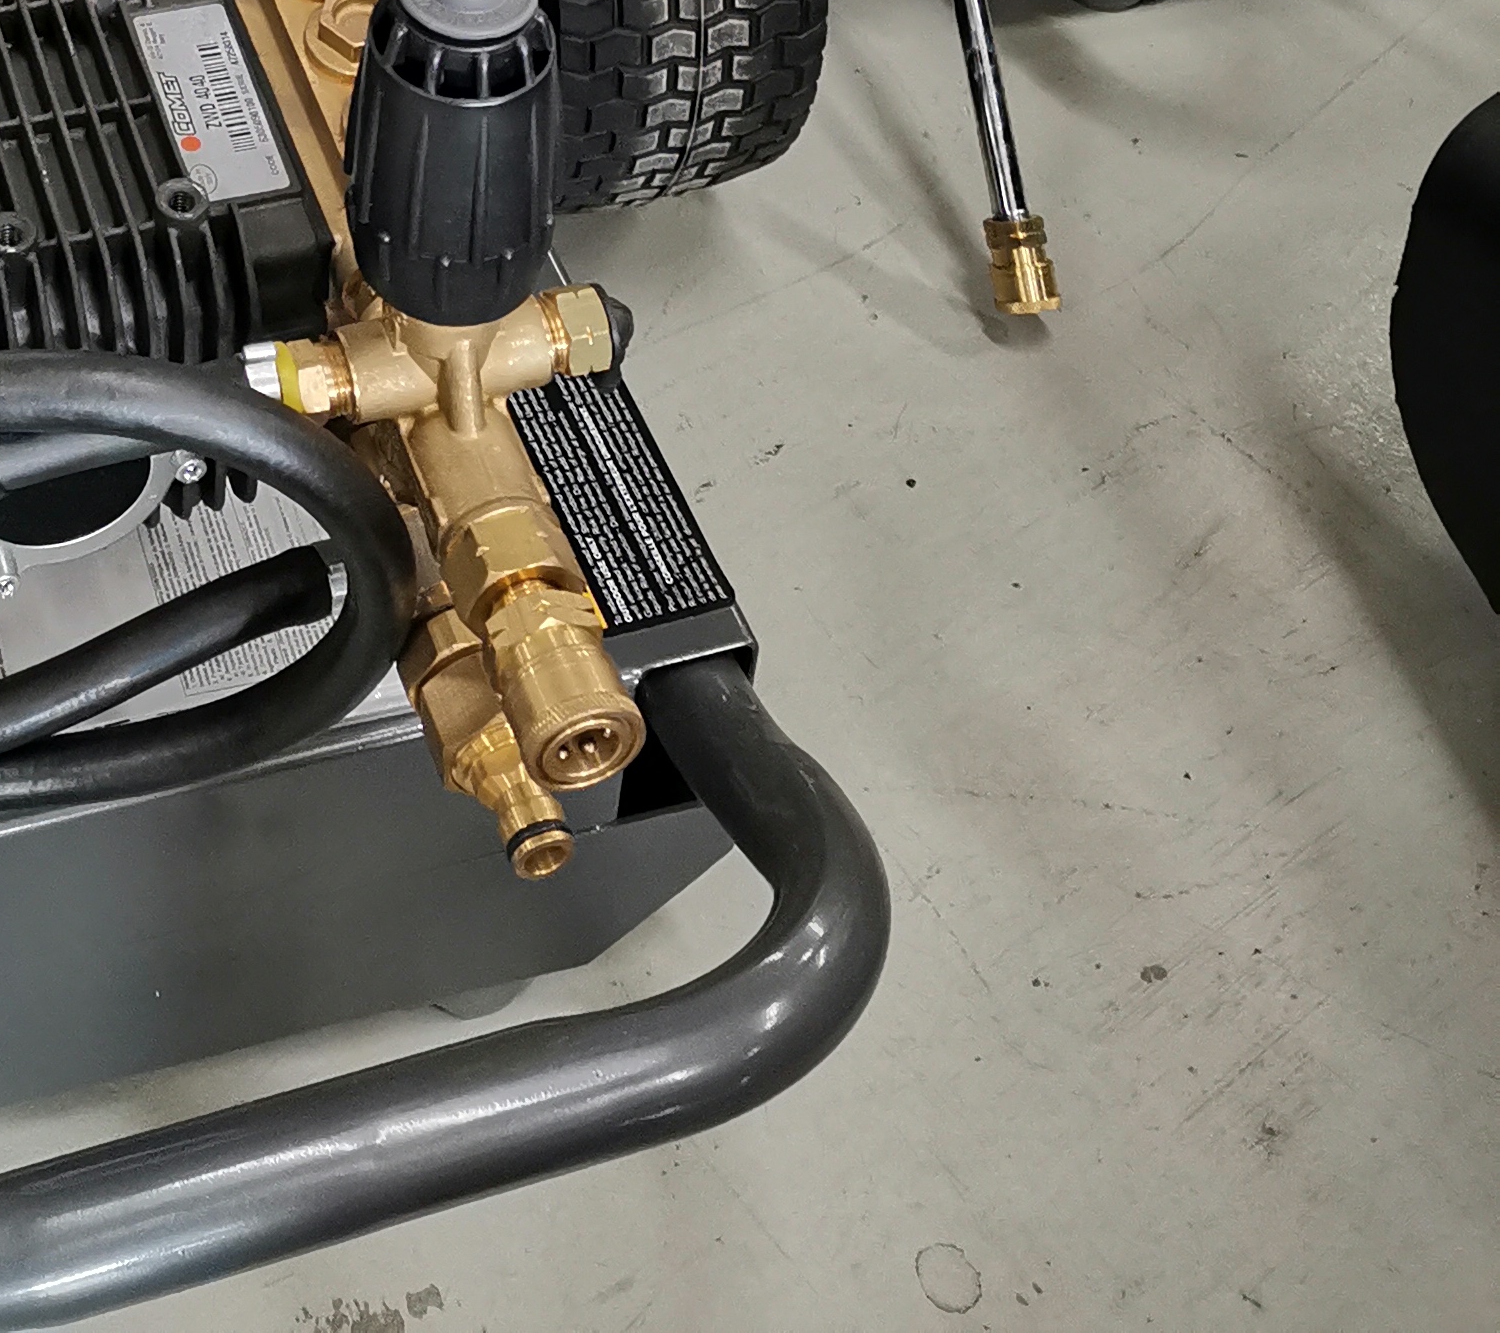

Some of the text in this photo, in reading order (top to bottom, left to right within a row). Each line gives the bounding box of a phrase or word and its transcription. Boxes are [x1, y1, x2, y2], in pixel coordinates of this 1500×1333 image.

[151, 67, 198, 138] COMET
[188, 73, 223, 129] ZWD 4040
[595, 558, 612, 579] USE
[604, 577, 634, 623] OUTDOOR
